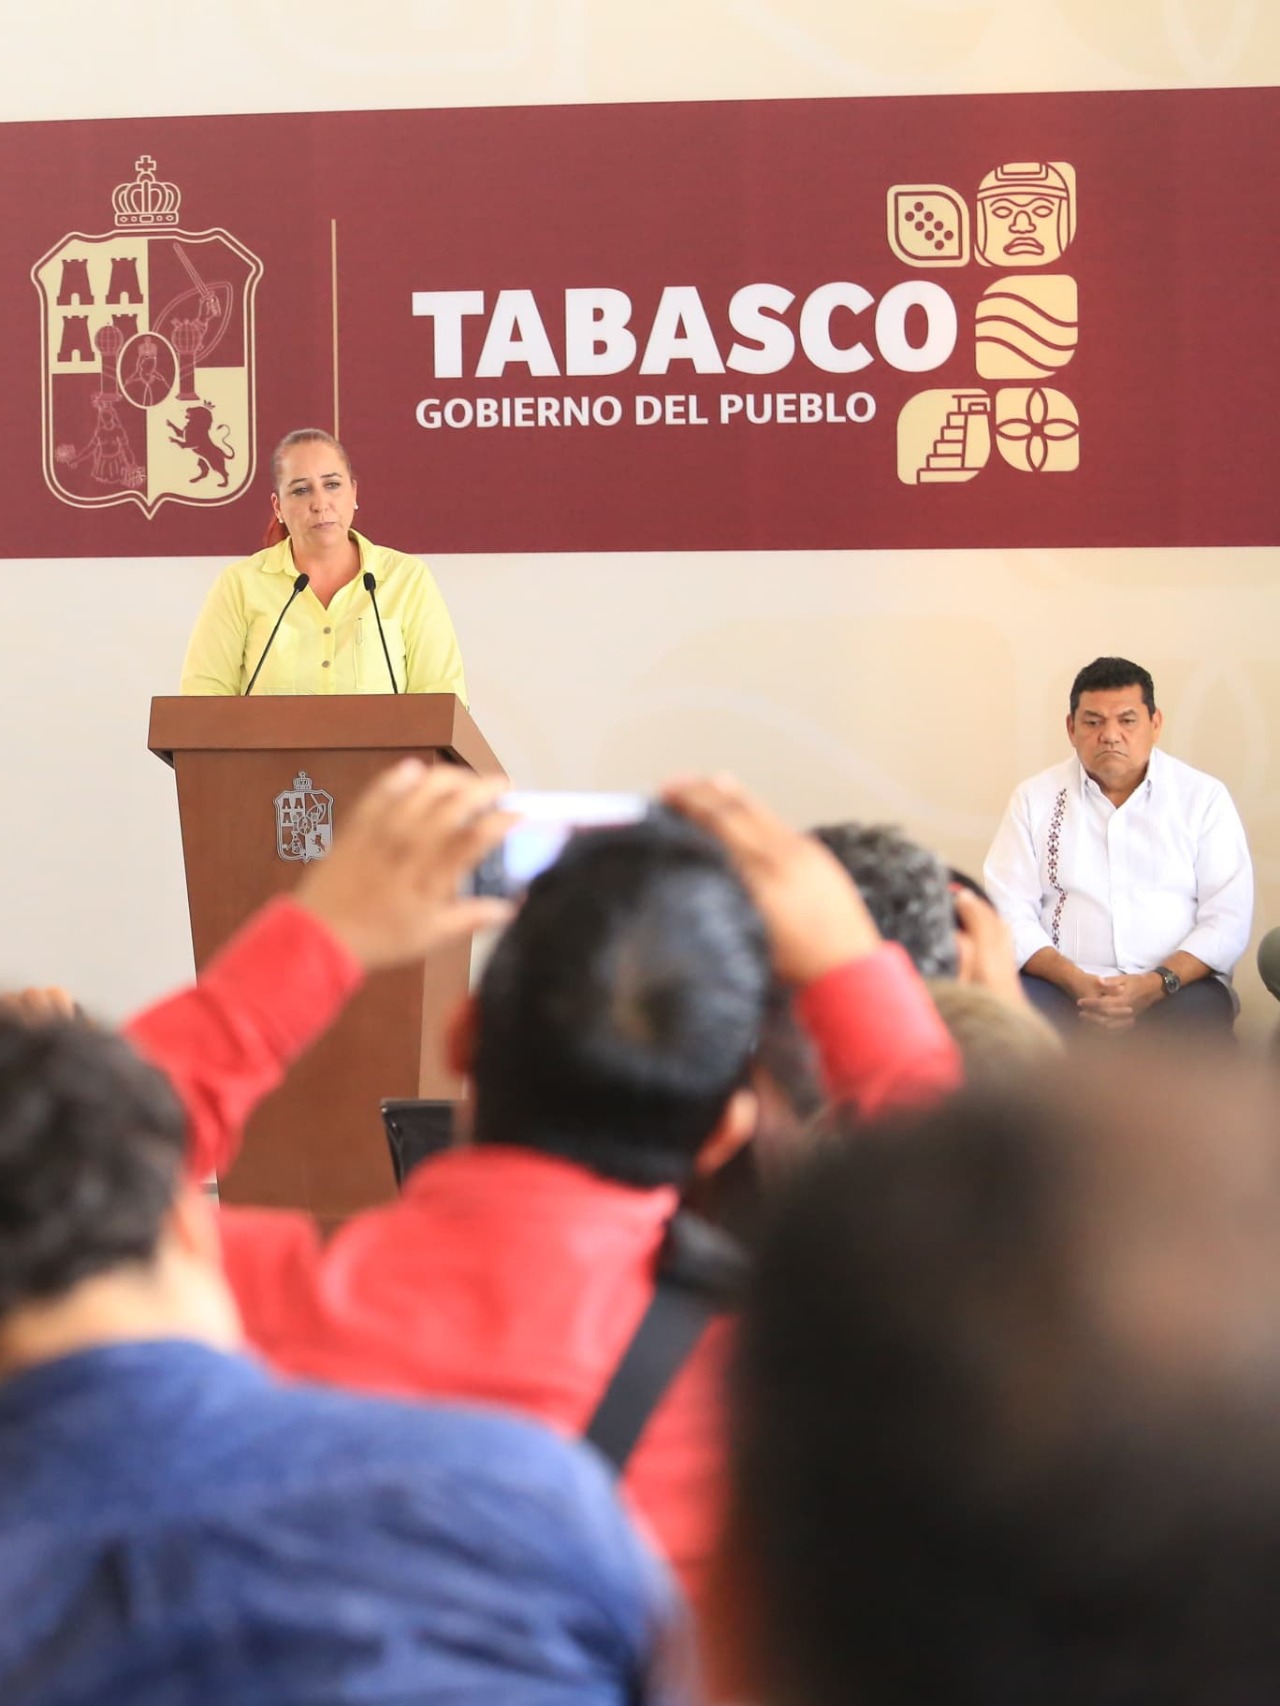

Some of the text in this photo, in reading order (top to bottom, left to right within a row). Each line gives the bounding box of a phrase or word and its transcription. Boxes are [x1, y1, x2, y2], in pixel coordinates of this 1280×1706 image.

[411, 279, 958, 380] TABASCO
[414, 390, 877, 430] GOBIERNO DEL PUEBLO
